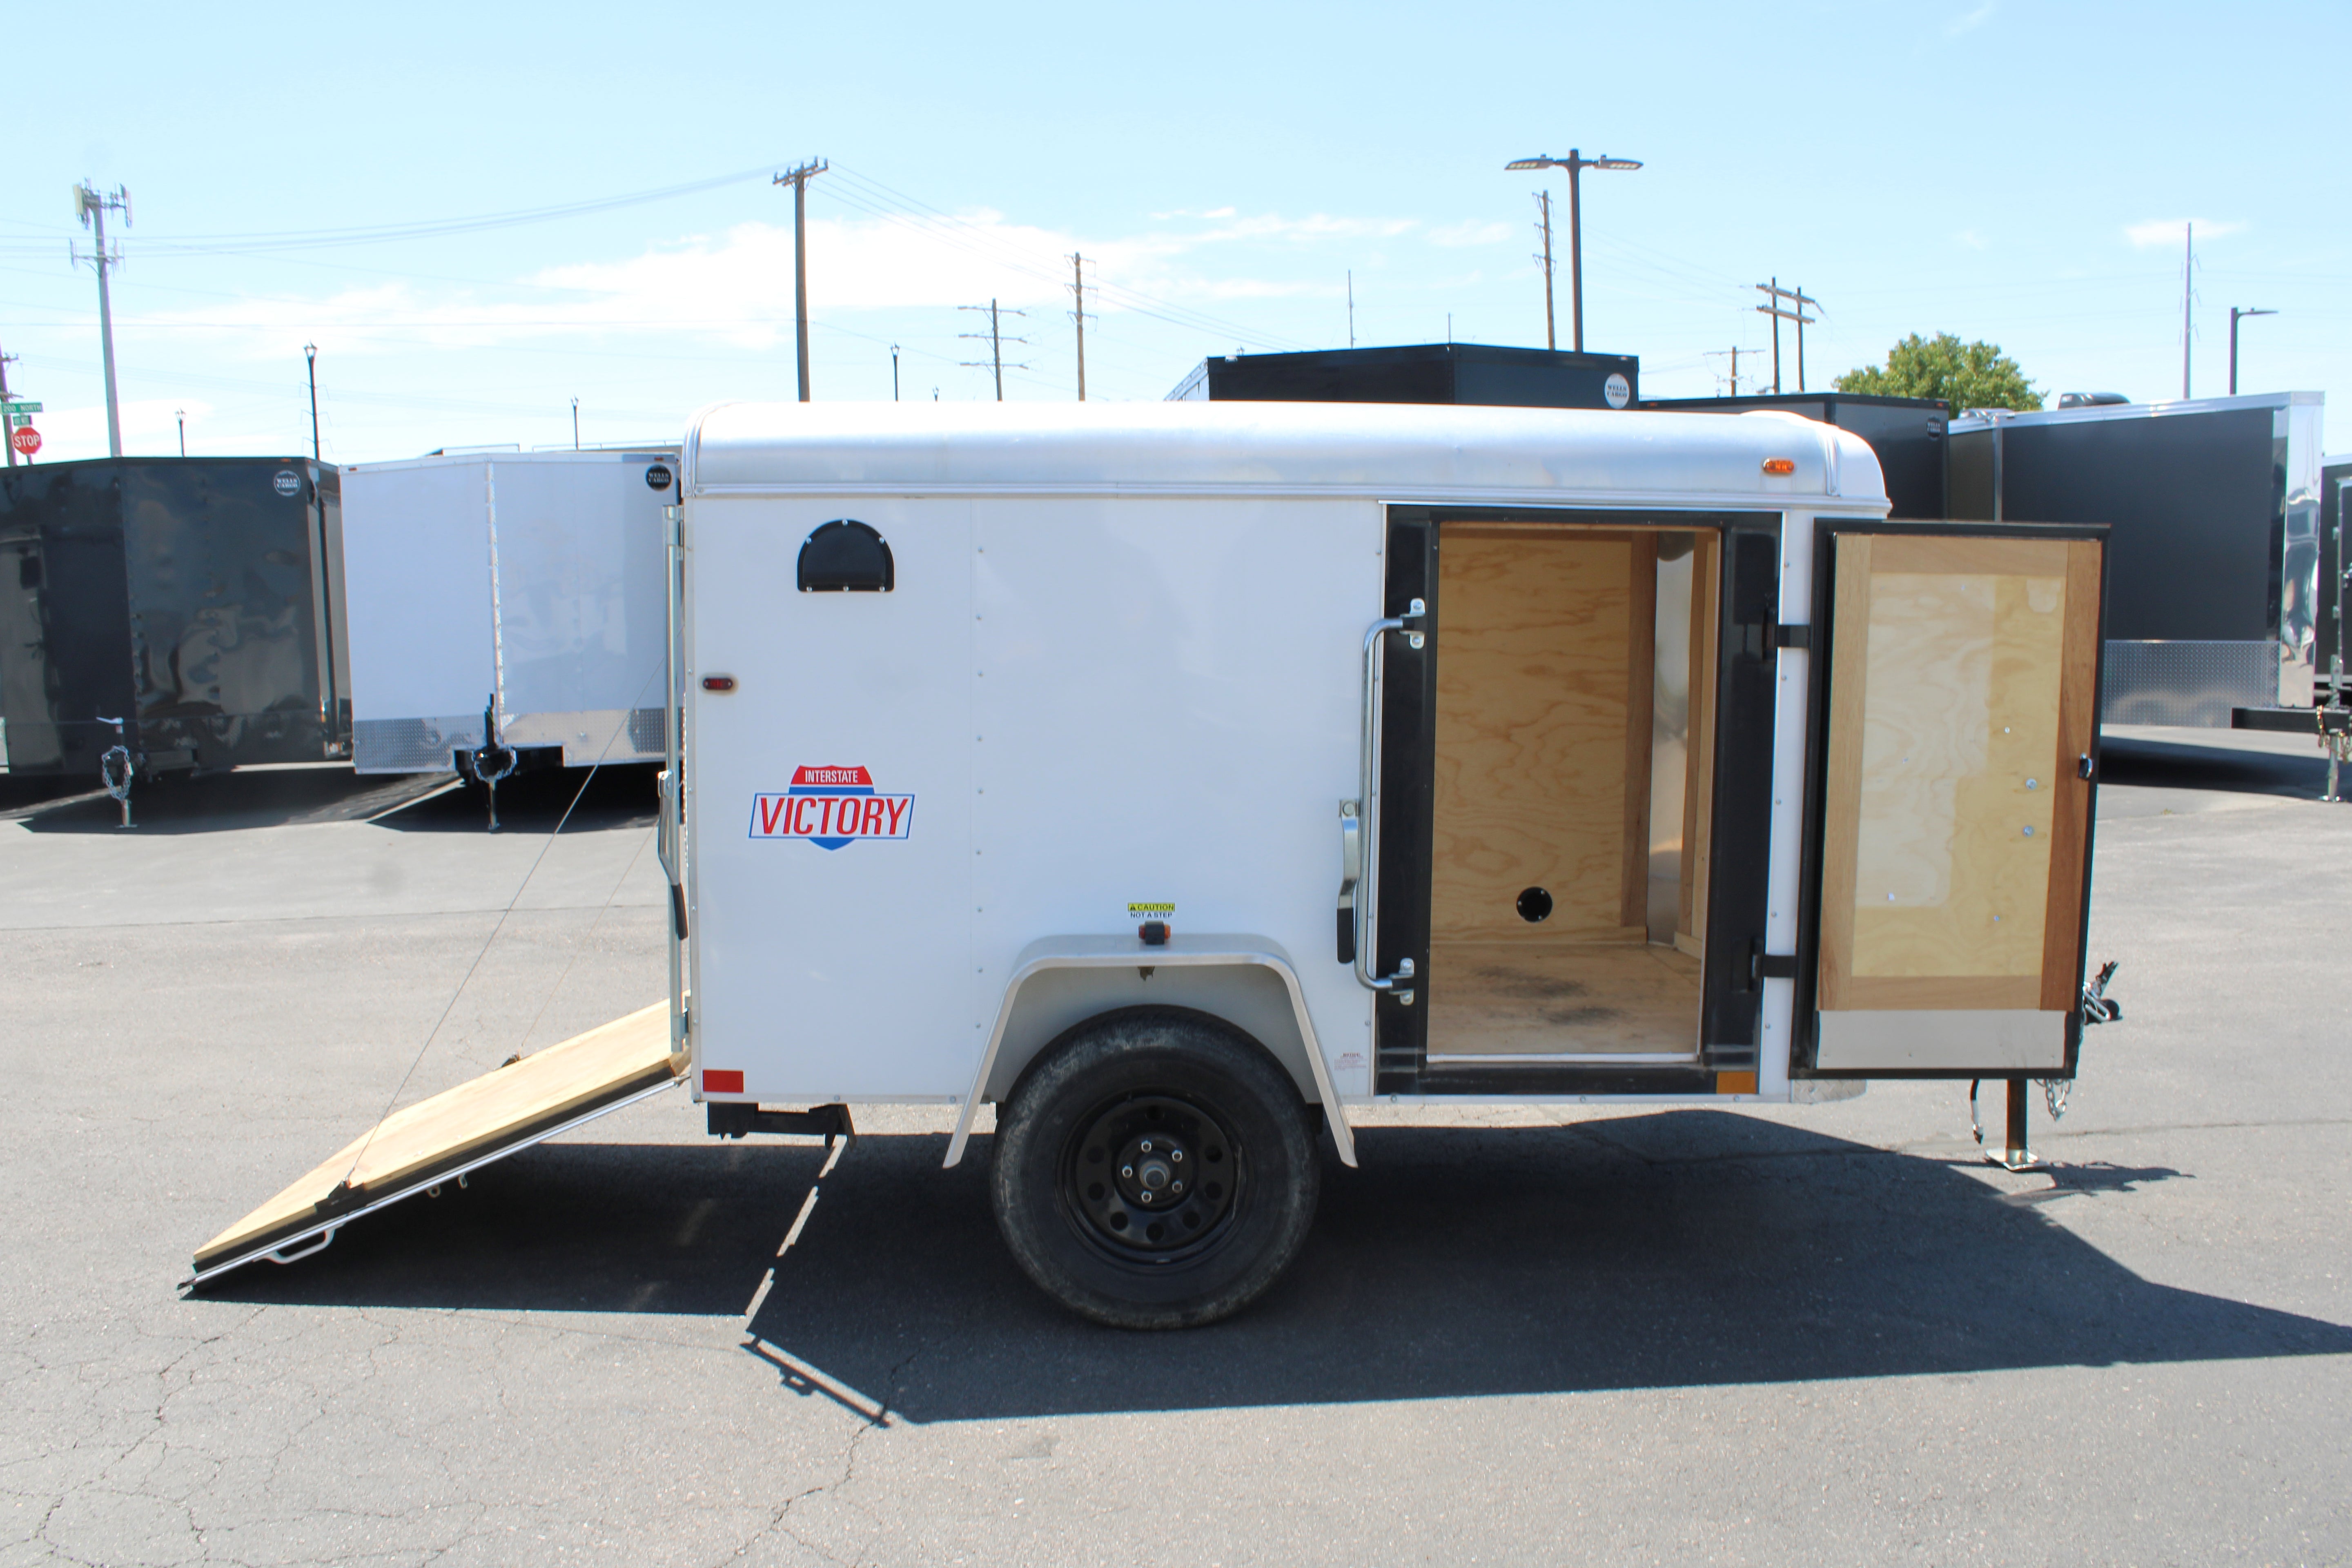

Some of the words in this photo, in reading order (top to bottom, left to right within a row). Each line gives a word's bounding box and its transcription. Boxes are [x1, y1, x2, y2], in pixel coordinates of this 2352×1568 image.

[20, 404, 41, 412] NORTH
[14, 434, 40, 448] STOP
[805, 770, 858, 783] INTERSTATE
[760, 797, 909, 835] VICTORY
